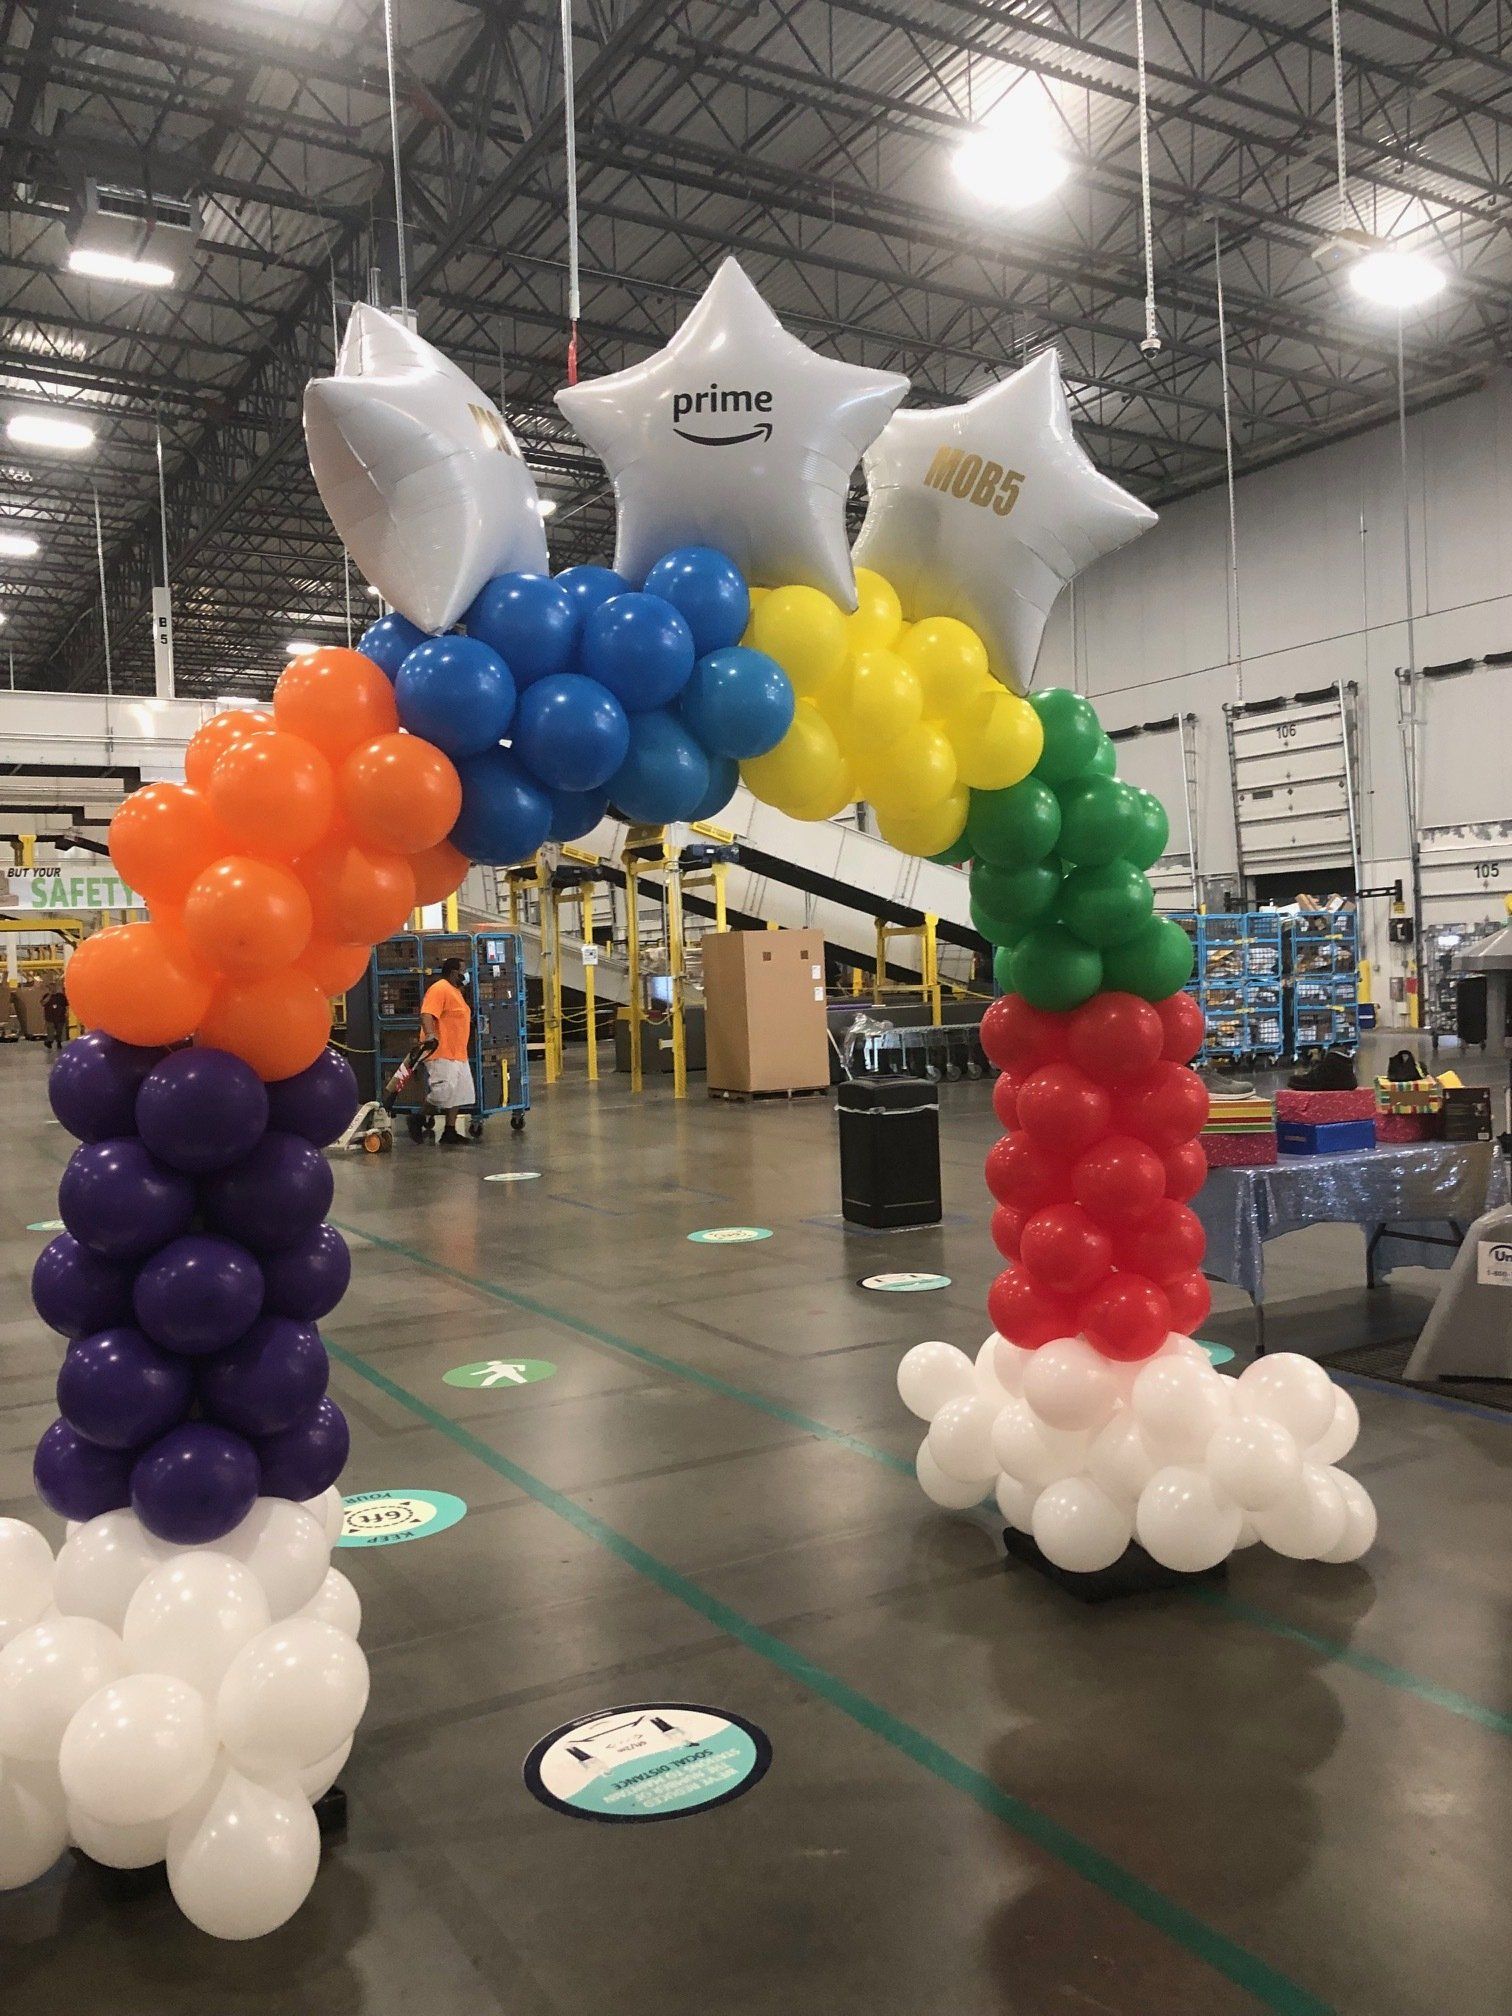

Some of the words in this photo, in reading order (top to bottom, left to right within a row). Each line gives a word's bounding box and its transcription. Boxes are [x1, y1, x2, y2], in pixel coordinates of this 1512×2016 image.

[673, 383, 773, 423] prime
[923, 444, 1026, 517] MOB5
[1276, 724, 1297, 739] 106
[7, 868, 29, 877] BUT
[32, 868, 61, 877] YOUR
[1474, 863, 1499, 878] 105
[31, 877, 133, 908] SAFETY
[360, 1510, 401, 1523] 6ft
[367, 1531, 415, 1543] KEEP
[669, 1748, 713, 1768] SOCIAL
[611, 1764, 671, 1790] DISTANCE
